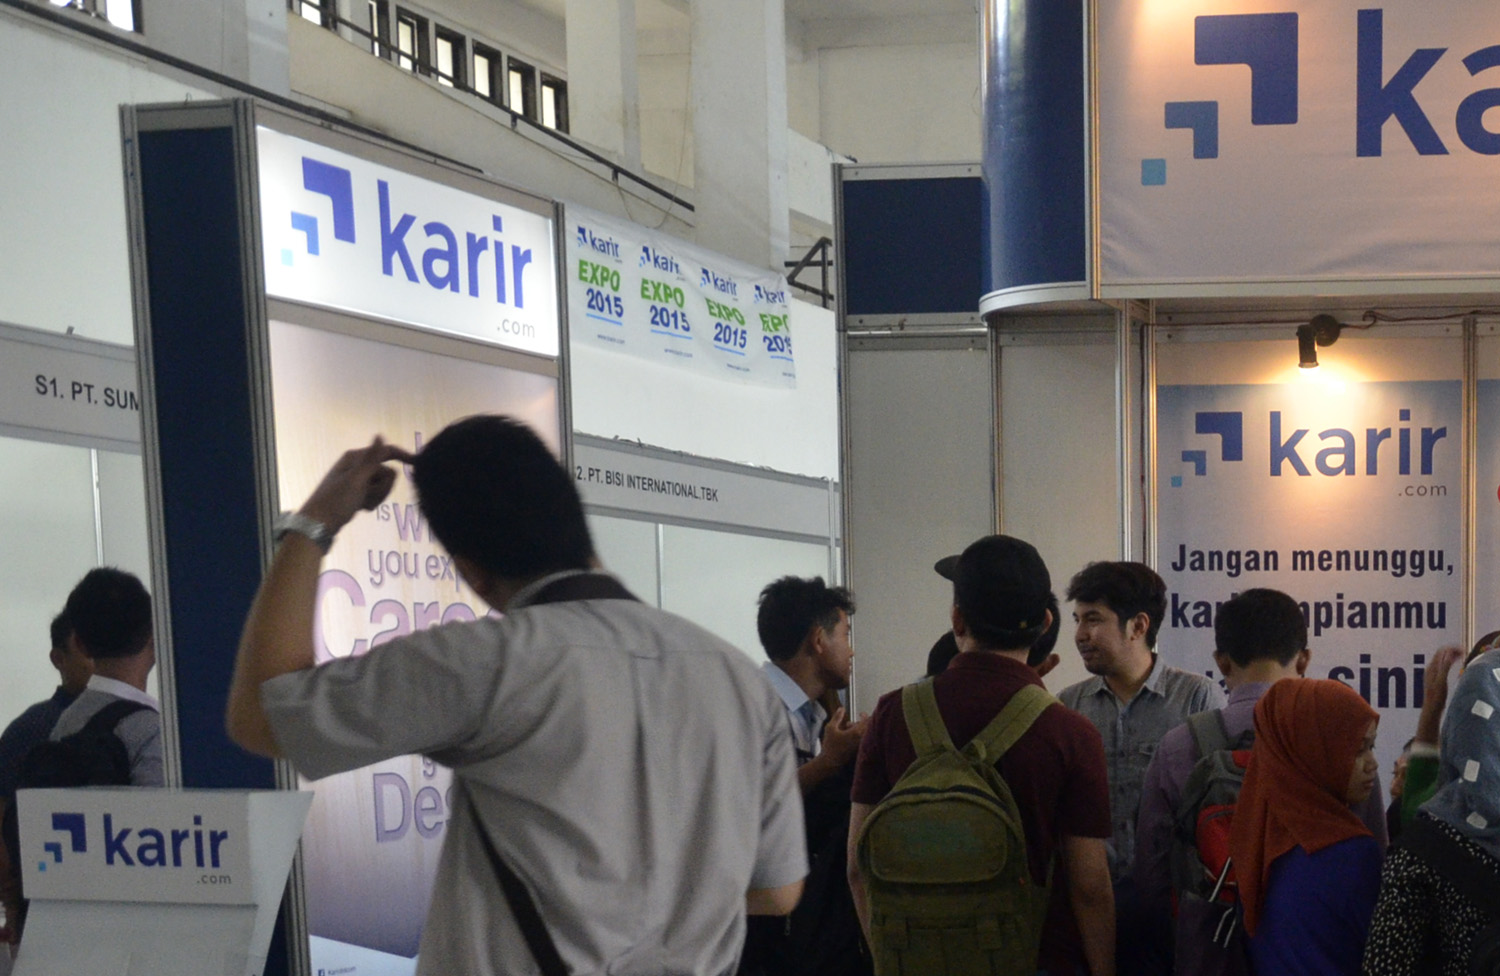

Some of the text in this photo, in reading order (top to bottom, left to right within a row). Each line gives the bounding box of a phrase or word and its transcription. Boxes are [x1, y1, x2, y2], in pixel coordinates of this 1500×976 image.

[377, 179, 532, 309] karir
[578, 259, 621, 292] EXPO
[586, 288, 624, 318] 2015
[640, 278, 685, 309] EXPO
[649, 304, 690, 332] 2015
[705, 297, 746, 326] EXPO
[496, 317, 535, 338] .com
[713, 322, 747, 349] 2015
[35, 374, 64, 399] S1.
[71, 381, 98, 405] PT.
[1269, 409, 1447, 477] karir
[588, 467, 604, 484] PT.
[605, 470, 624, 487] BISI
[1398, 484, 1447, 497] .com
[367, 549, 418, 588] you
[1171, 543, 1454, 578] Jangan menunggu,
[1300, 592, 1447, 637] pianmu
[103, 813, 228, 868] karir
[196, 874, 232, 884] .com
